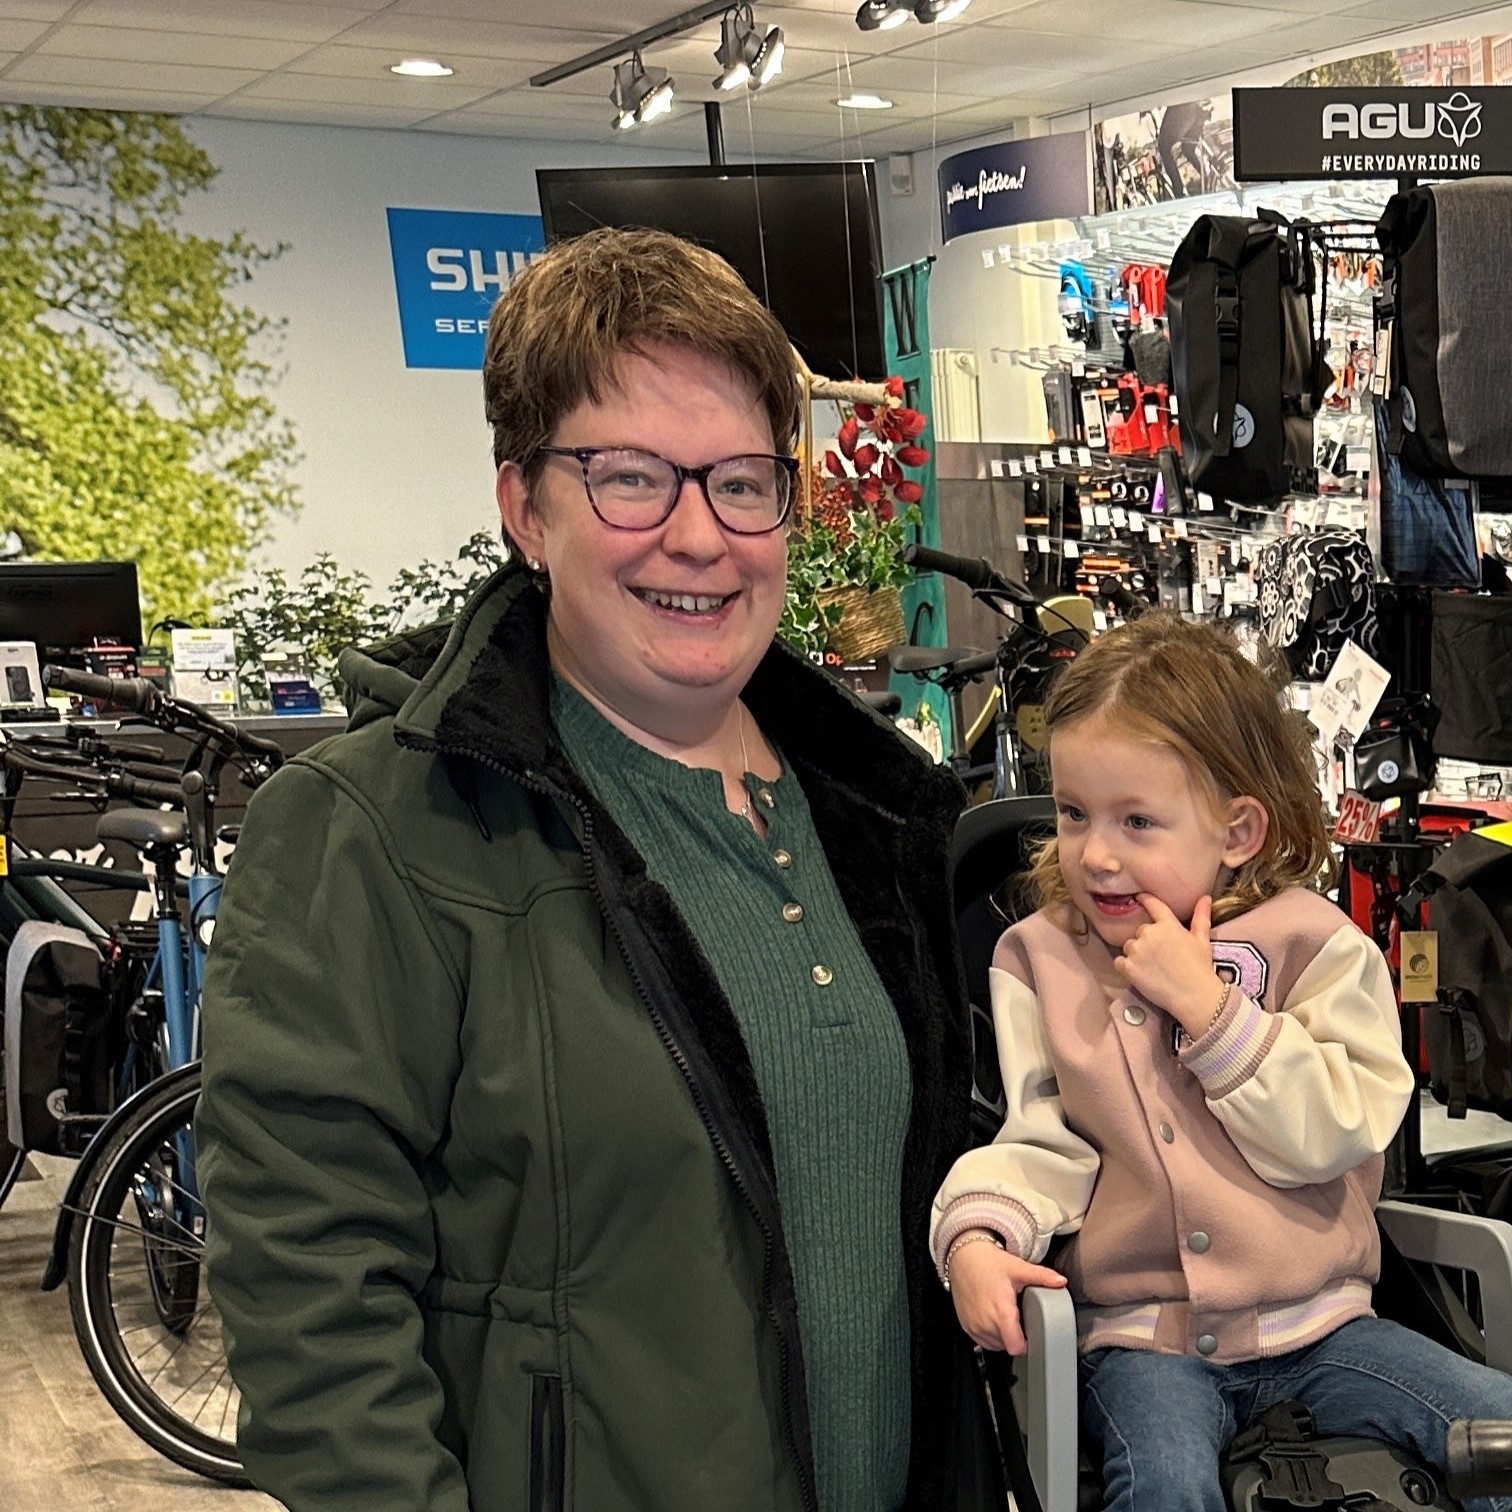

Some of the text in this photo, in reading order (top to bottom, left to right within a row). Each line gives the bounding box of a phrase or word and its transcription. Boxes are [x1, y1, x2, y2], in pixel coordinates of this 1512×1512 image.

[1322, 103, 1436, 139] AGU
[1321, 154, 1481, 172] #EVERYDAYRIDING
[1337, 798, 1378, 840] 25%
